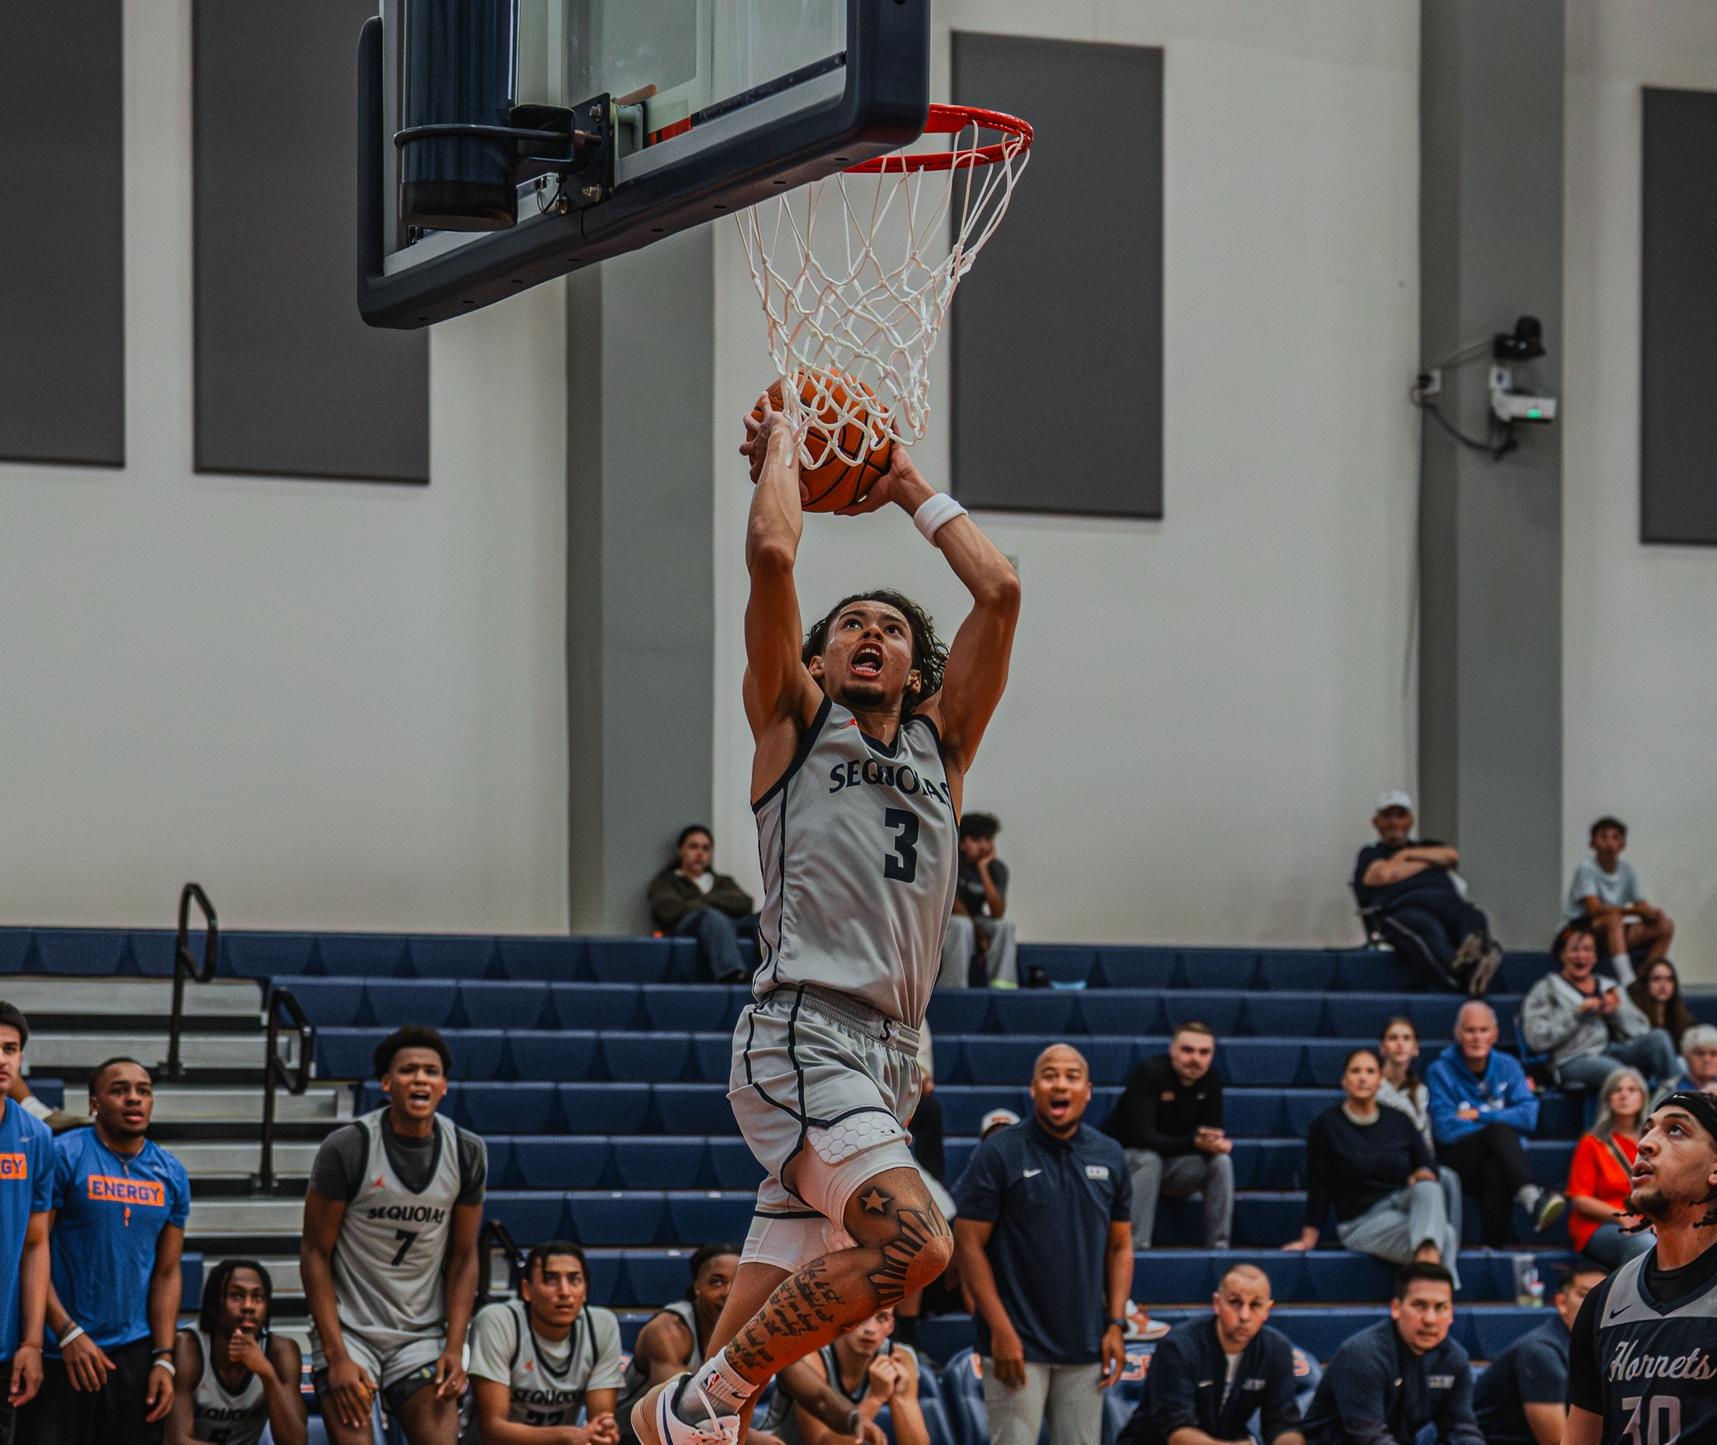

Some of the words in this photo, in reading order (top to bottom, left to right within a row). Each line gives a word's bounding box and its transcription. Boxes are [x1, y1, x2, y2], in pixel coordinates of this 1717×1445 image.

[884, 807, 919, 883] 3
[0, 1158, 23, 1175] GY
[92, 1180, 160, 1201] ENERGY
[391, 1228, 418, 1266] 7
[1608, 1339, 1717, 1382] Hornets
